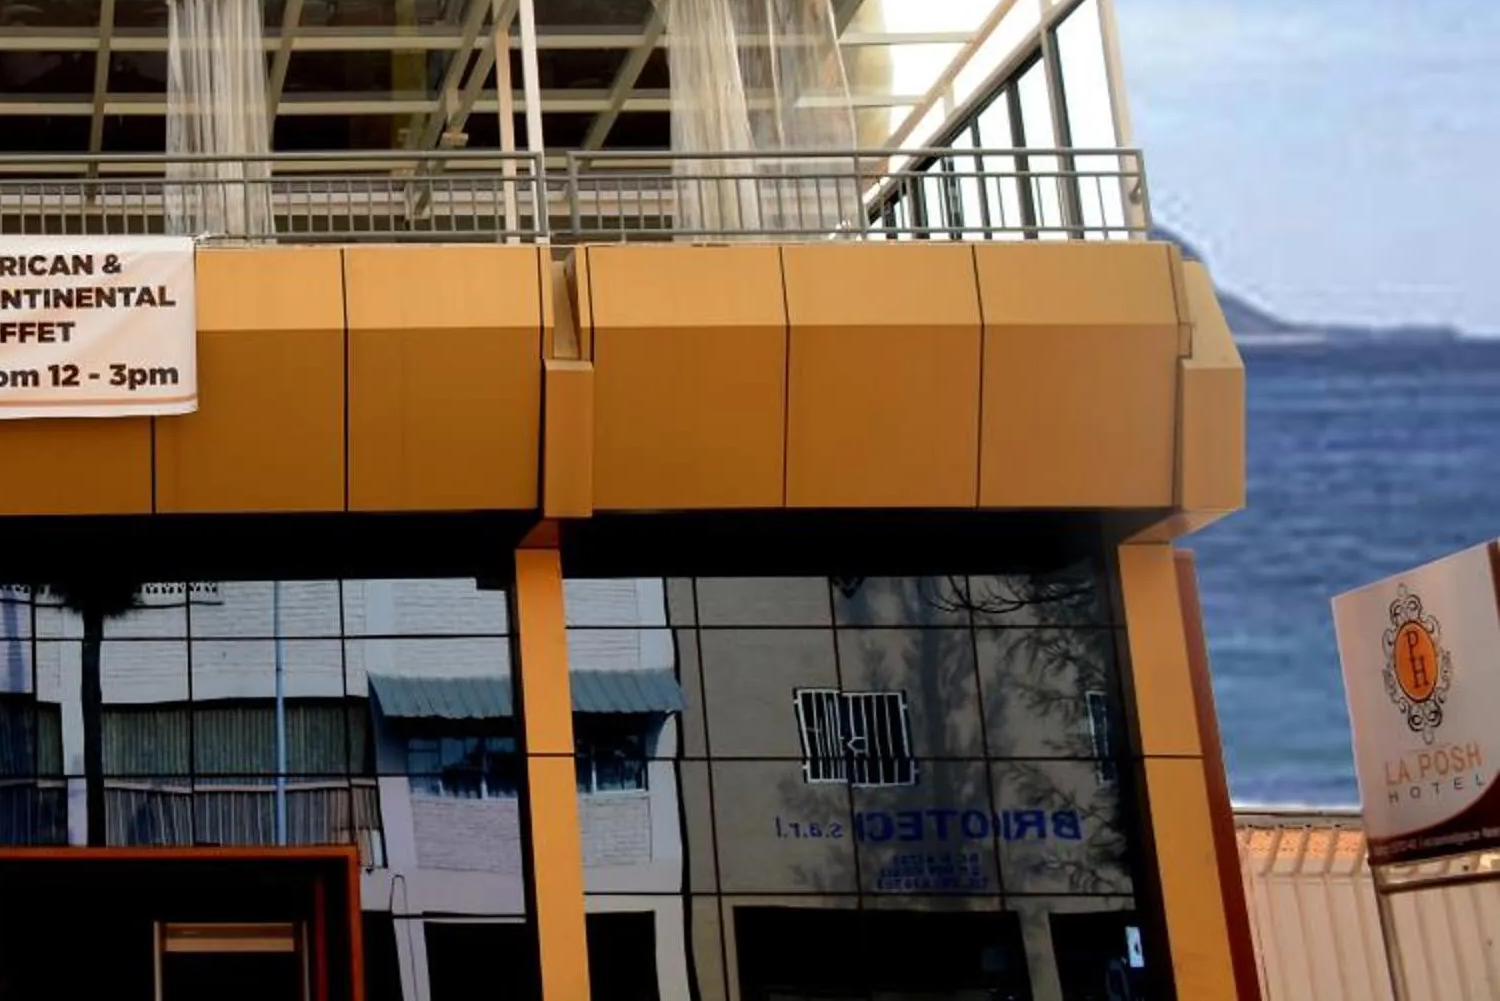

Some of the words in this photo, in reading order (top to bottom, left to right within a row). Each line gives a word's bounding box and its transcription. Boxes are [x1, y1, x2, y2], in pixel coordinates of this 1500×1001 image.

[101, 254, 122, 274] &
[47, 364, 81, 387] 12
[109, 363, 179, 390] 3pm
[1385, 759, 1412, 786] LA
[1418, 742, 1483, 778] POSH
[1388, 773, 1485, 803] HOTEL
